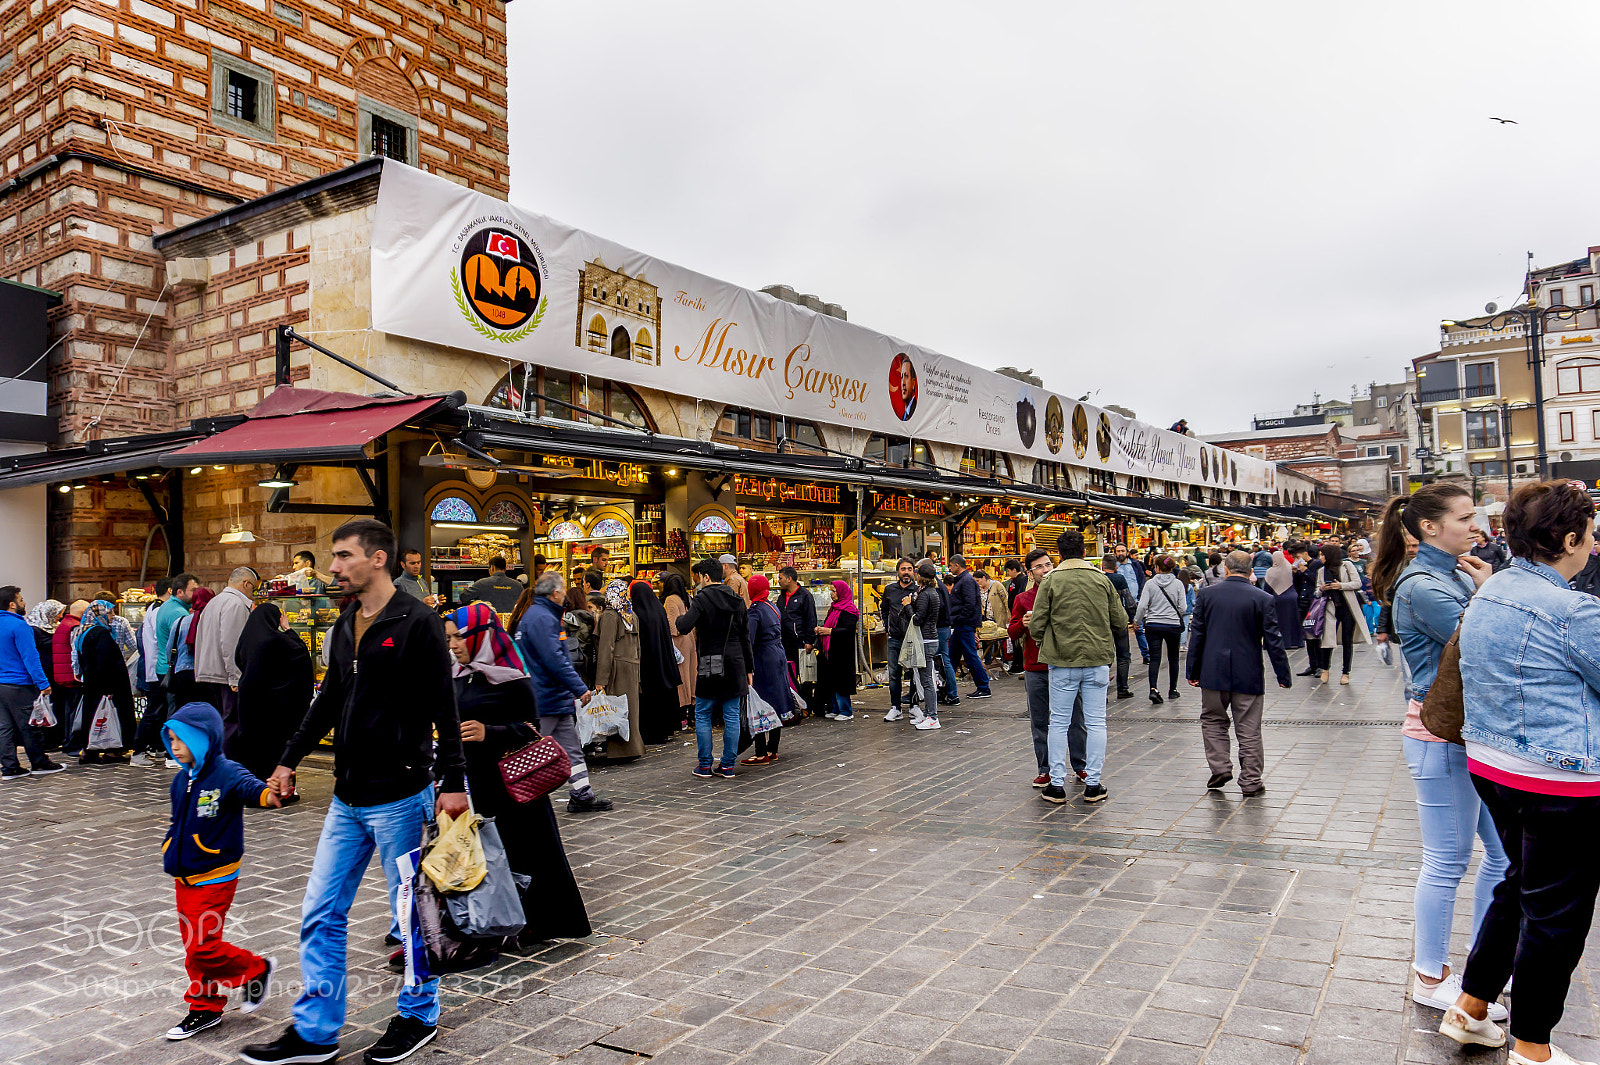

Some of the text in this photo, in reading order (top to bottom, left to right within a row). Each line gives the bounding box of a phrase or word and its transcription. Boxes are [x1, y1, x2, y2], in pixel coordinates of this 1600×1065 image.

[513, 223, 530, 240] GENEL
[673, 290, 707, 312] Tarihi
[492, 308, 506, 319] 1048
[674, 318, 871, 409] Mısır Çarşısı
